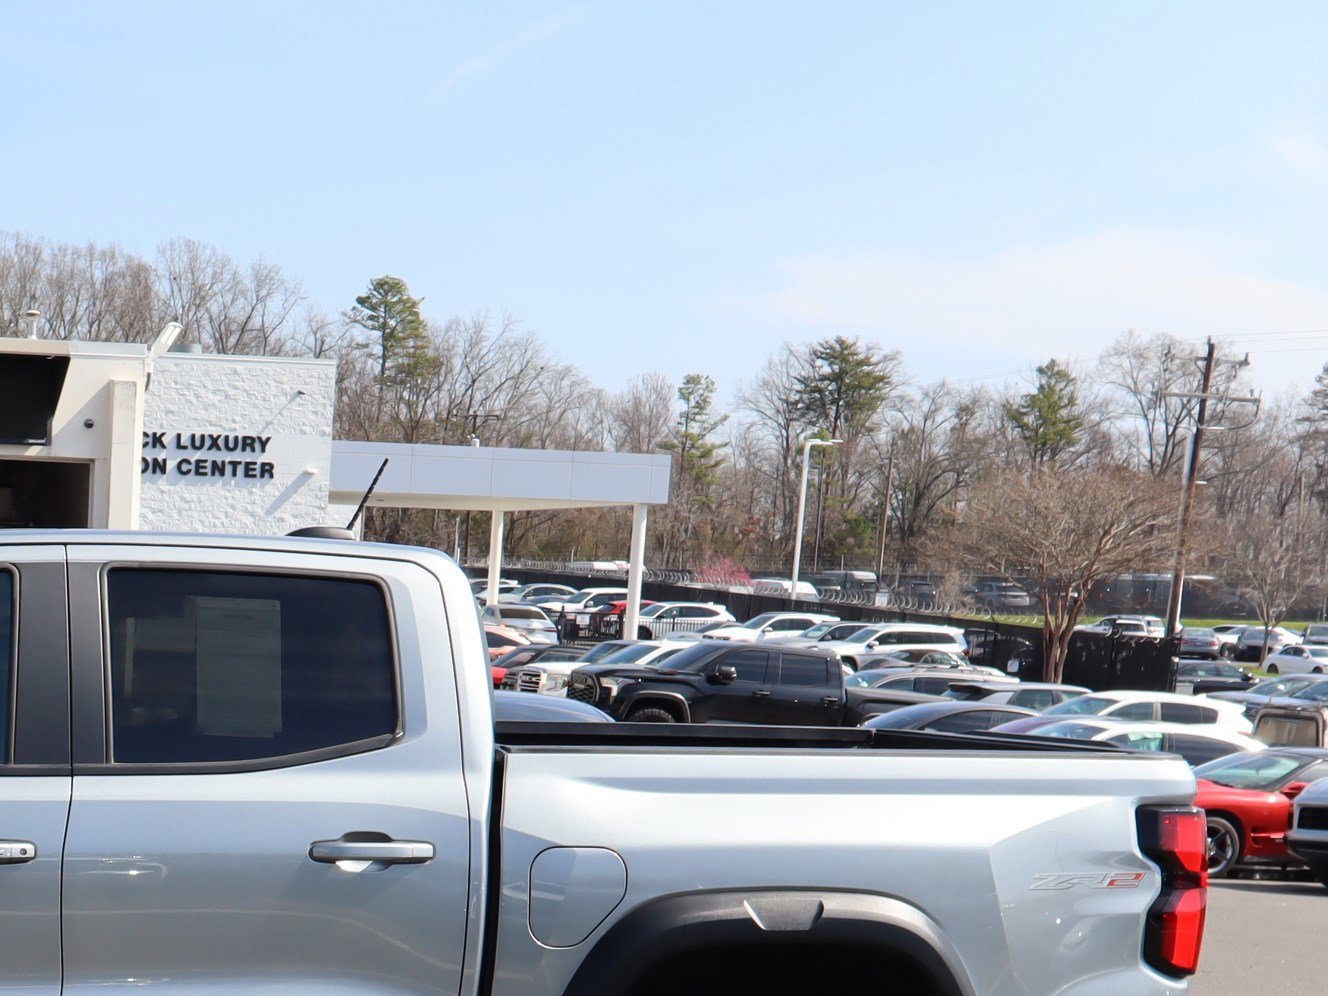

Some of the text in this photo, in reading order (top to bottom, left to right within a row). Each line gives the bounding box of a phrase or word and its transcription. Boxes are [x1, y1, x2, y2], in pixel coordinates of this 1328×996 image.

[176, 432, 272, 453] LUXURY
[176, 458, 275, 479] CENTER
[1027, 871, 1147, 891] ZR2
